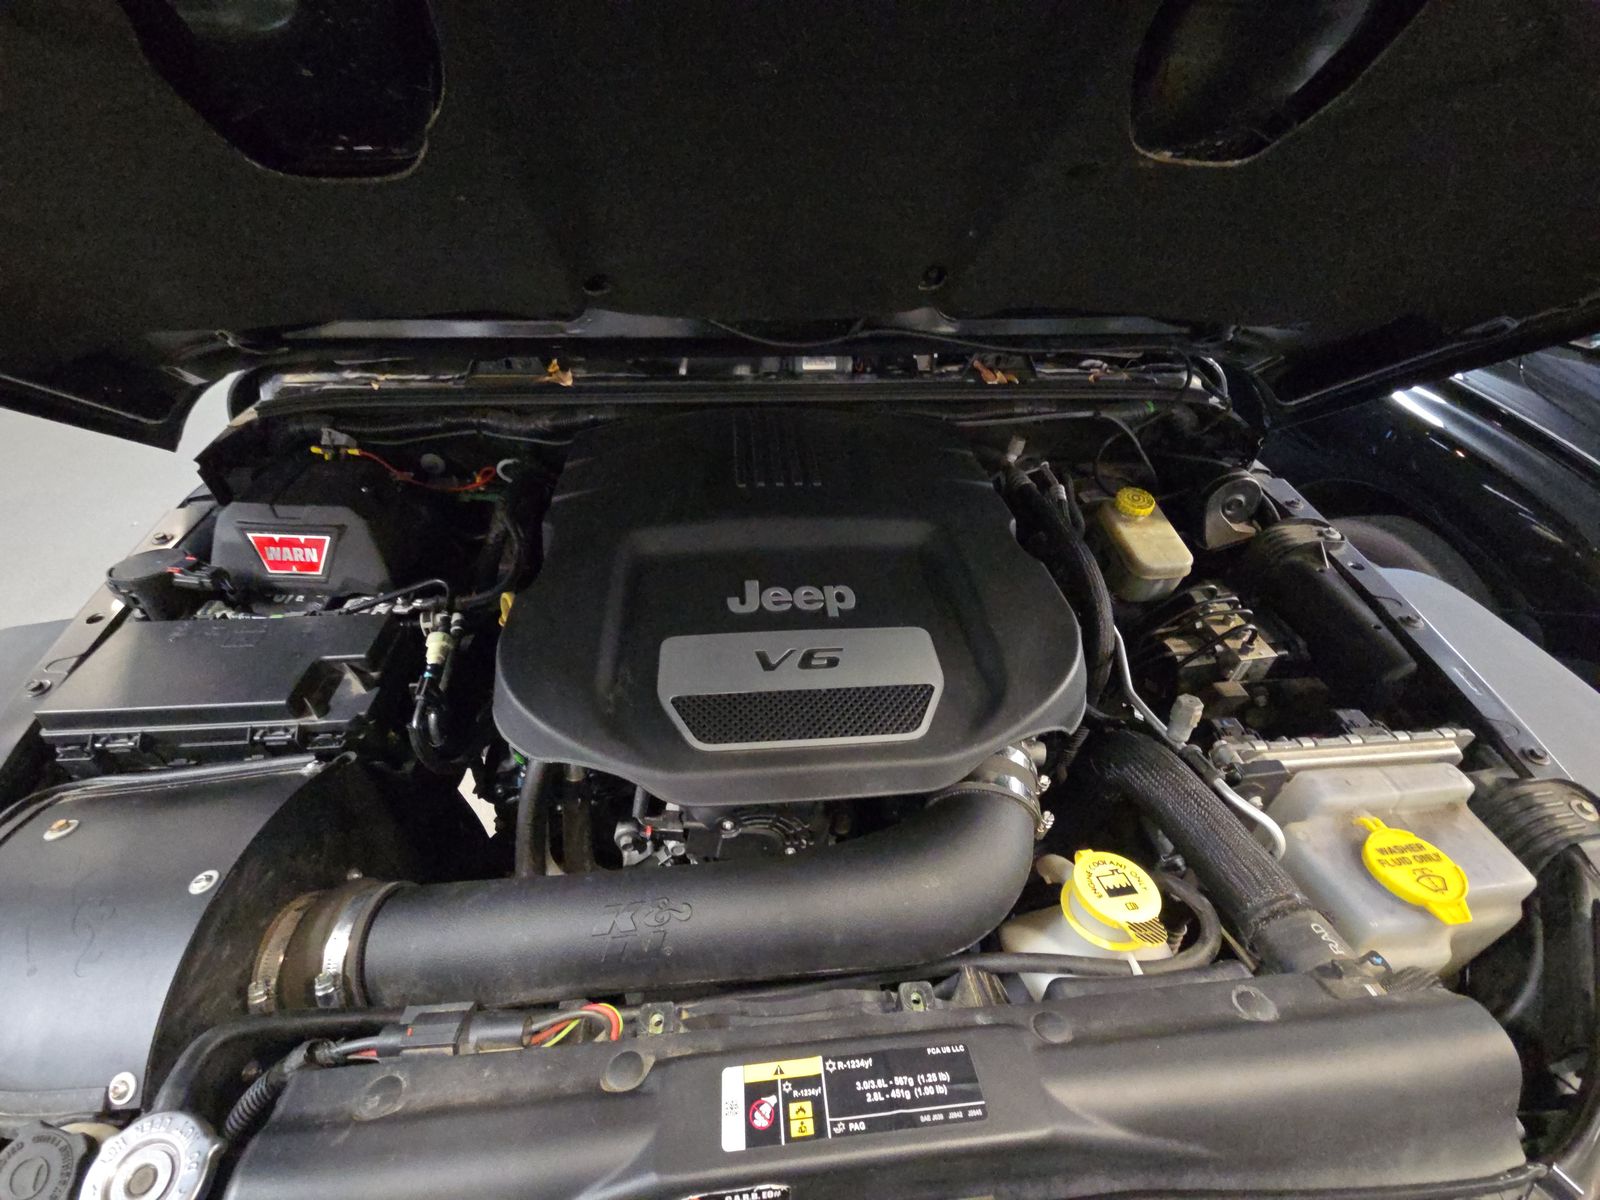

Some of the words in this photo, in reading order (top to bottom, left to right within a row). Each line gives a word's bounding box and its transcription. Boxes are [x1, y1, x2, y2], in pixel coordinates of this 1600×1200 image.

[264, 546, 319, 563] WARN
[727, 579, 857, 618] Jeep
[754, 647, 844, 672] V6
[1375, 842, 1427, 856] WASHER
[1376, 856, 1413, 868] FLUID
[1413, 852, 1443, 864] ONLY
[926, 1047, 942, 1056] FCA
[941, 1046, 952, 1054] US
[951, 1044, 965, 1053] LLC
[837, 1057, 873, 1070] R-1234yf
[938, 1071, 950, 1083] lb)
[935, 1084, 948, 1096] lb)
[848, 1121, 866, 1132] PAG
